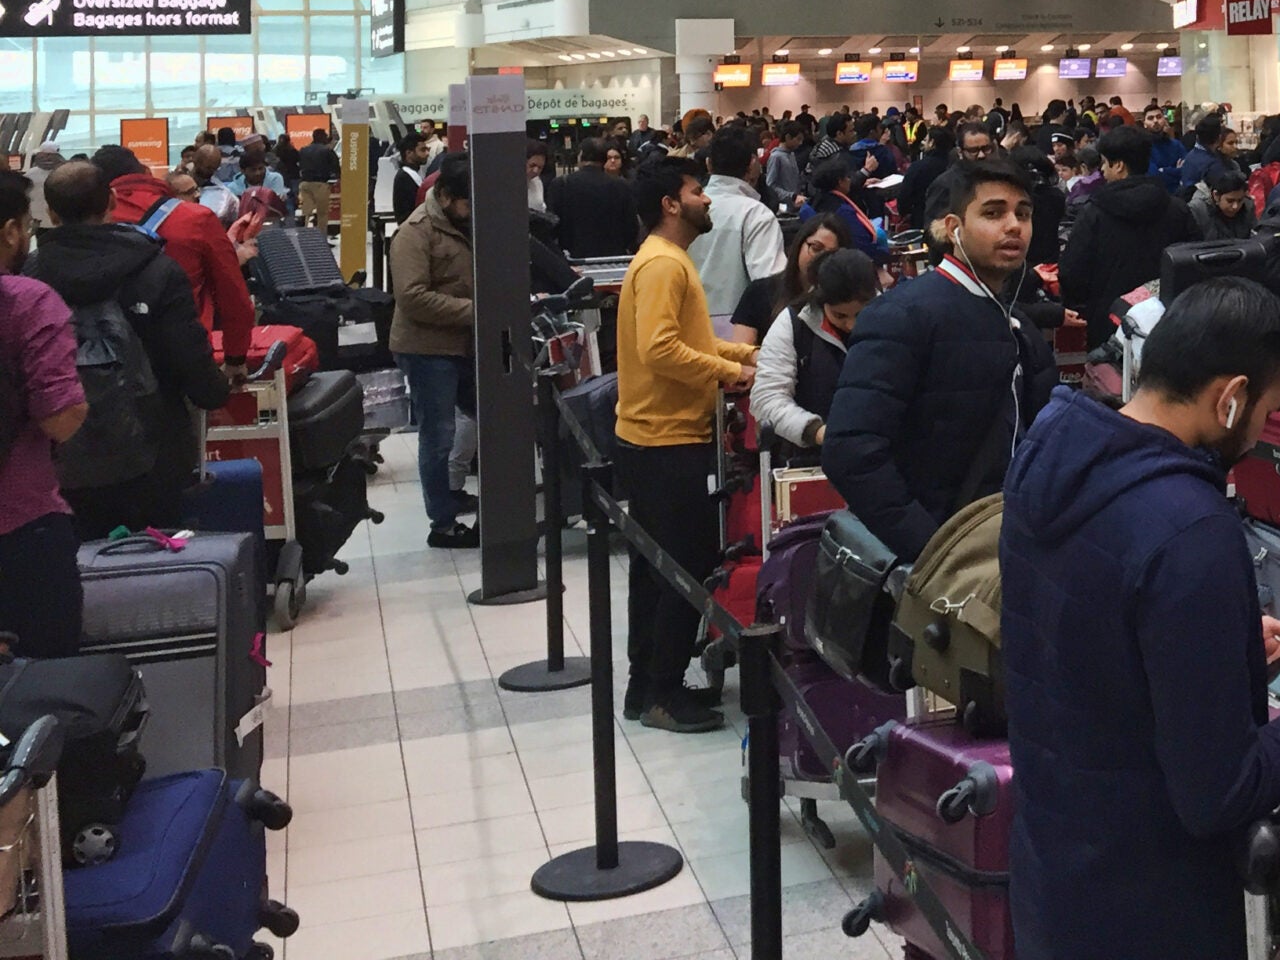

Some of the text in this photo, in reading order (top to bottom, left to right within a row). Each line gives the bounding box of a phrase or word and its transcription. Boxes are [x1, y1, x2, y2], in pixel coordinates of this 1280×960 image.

[73, 10, 240, 29] Bagages hors format
[528, 97, 627, 111] Dépôt de bagages
[212, 125, 251, 136] swing
[128, 137, 162, 148] sunwing
[349, 131, 359, 171] Business
